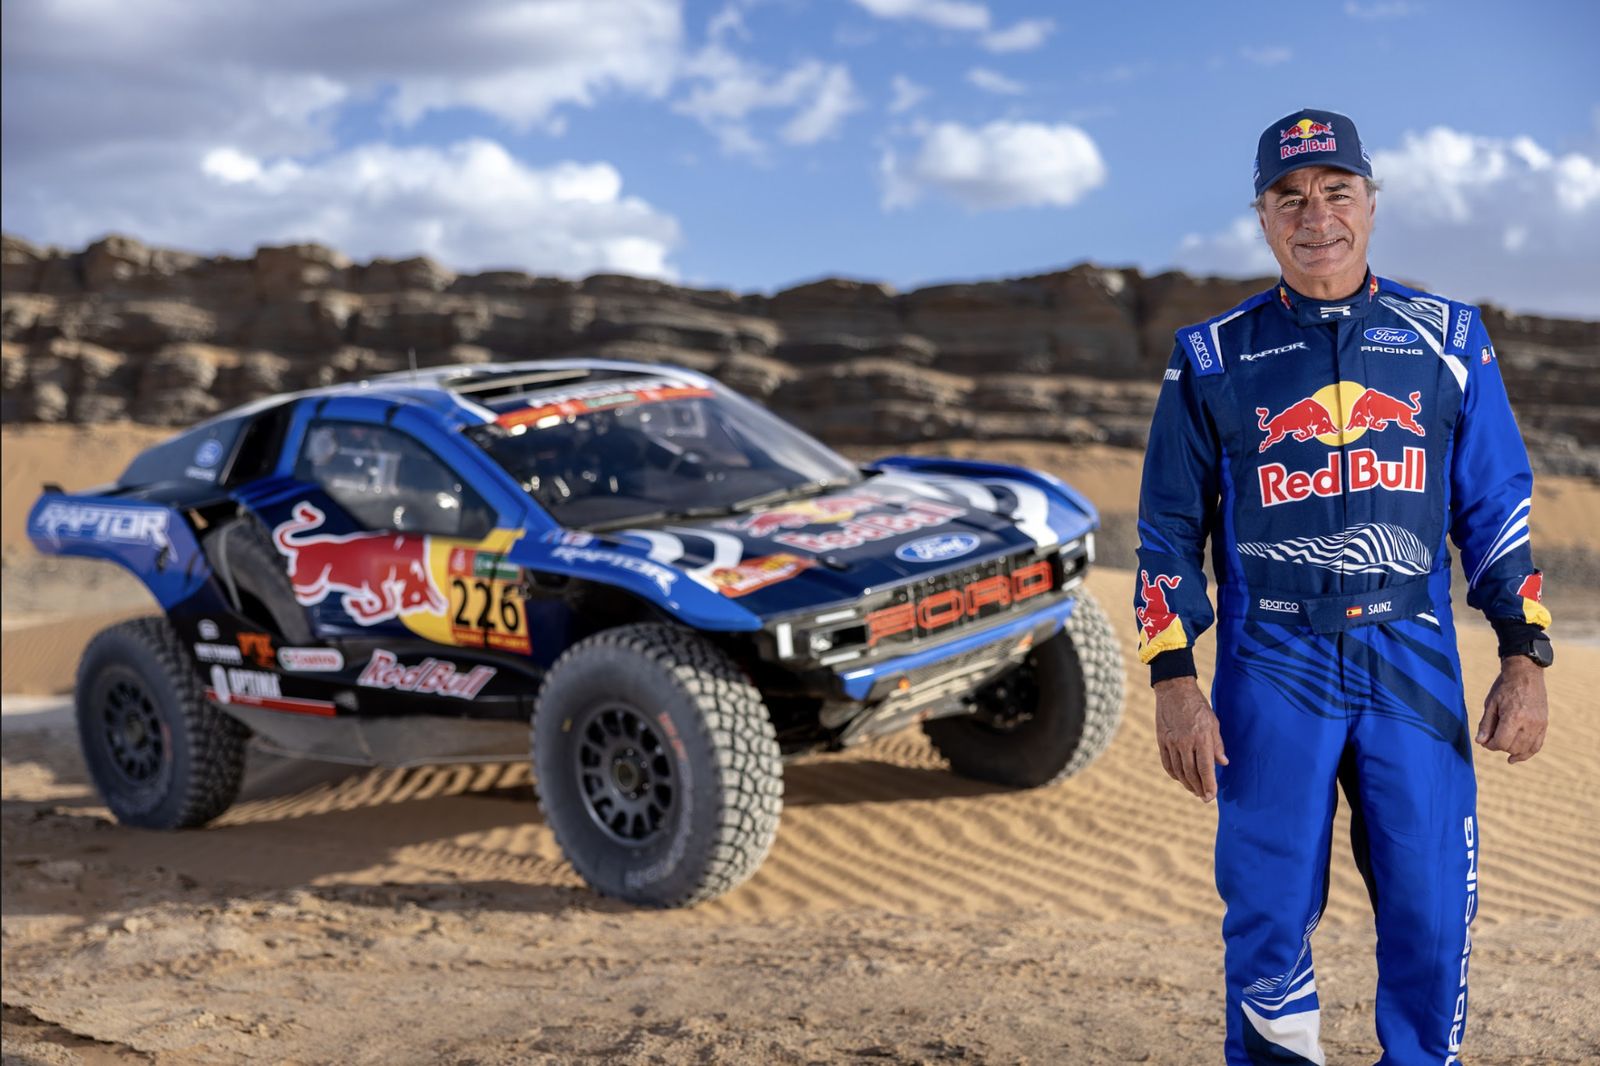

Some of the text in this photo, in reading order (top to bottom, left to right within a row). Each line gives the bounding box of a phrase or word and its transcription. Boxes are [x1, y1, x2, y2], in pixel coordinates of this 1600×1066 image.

[1281, 138, 1336, 159] Red Bull
[1373, 328, 1408, 343] Ford
[1453, 309, 1472, 349] sparco
[1189, 331, 1212, 370] sparco
[1240, 341, 1309, 361] RAPTOR
[1360, 346, 1424, 355] RACING
[1257, 446, 1426, 508] Red Bull
[37, 502, 176, 556] RAPTOR
[453, 579, 519, 632] 226
[864, 560, 1054, 648] FORD
[1259, 598, 1300, 613] sparco
[1368, 601, 1392, 615] SAINZ
[357, 649, 437, 692] Red
[417, 659, 497, 700] Bull
[1445, 991, 1466, 1066] RD
